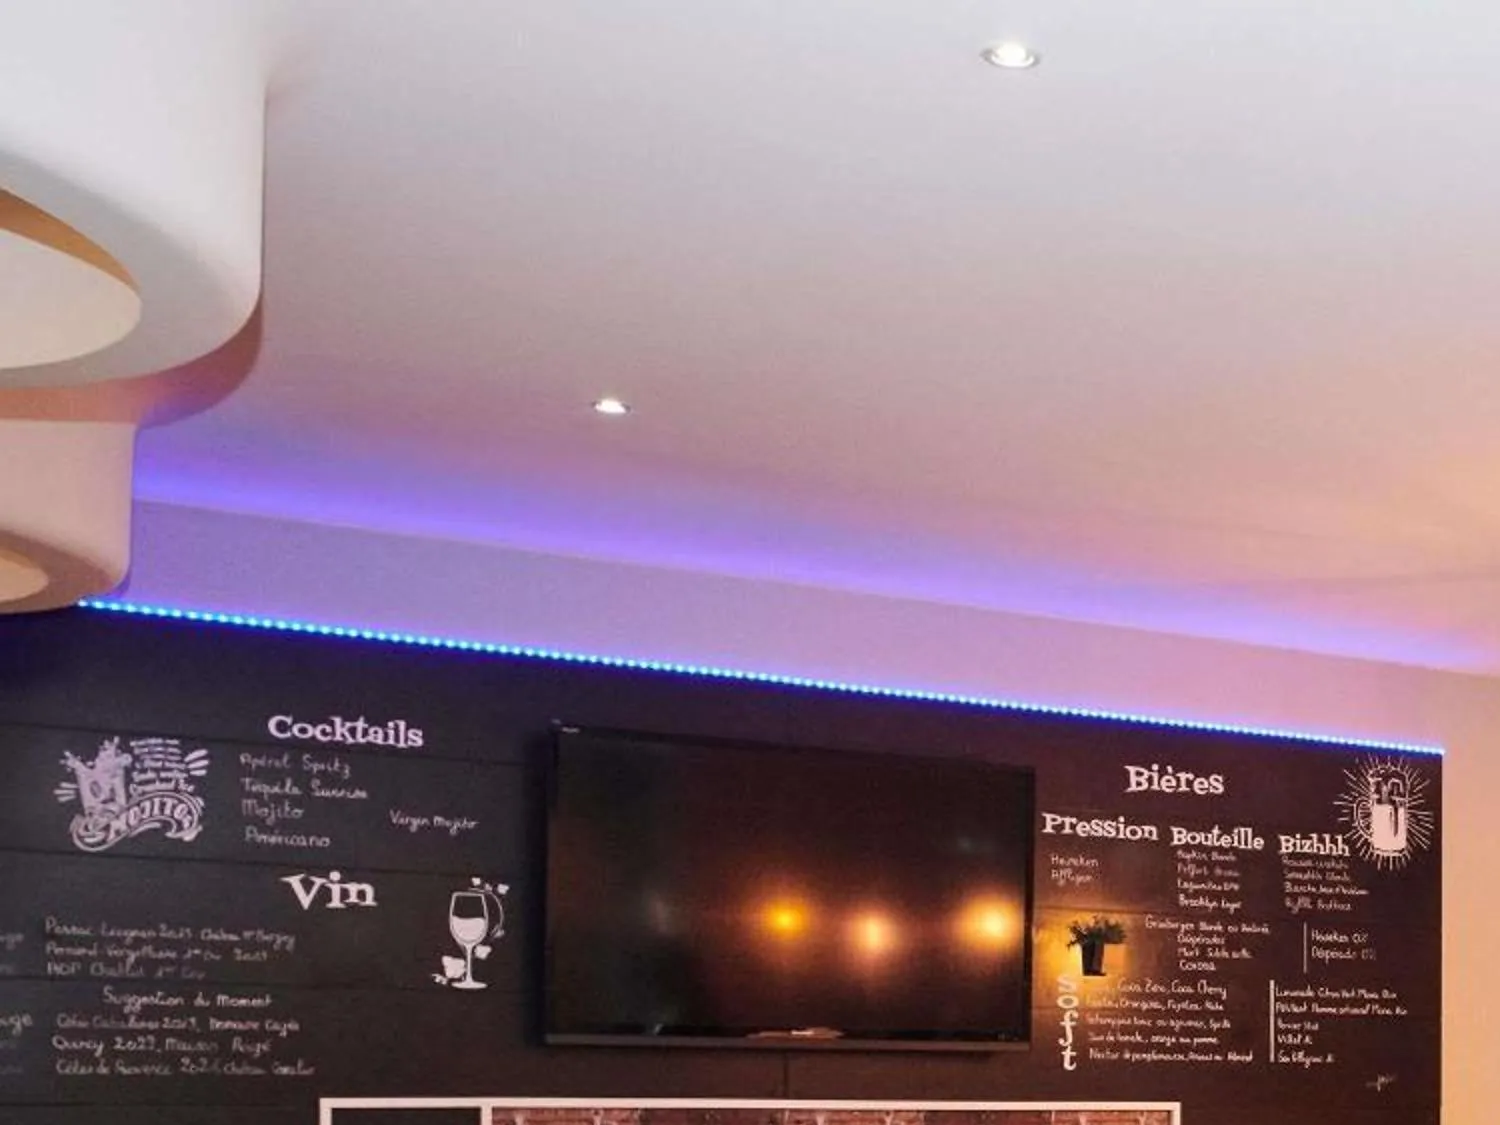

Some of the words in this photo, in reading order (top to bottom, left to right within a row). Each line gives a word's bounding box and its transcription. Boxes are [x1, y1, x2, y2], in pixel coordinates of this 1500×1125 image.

[267, 715, 424, 748] Cocktails
[302, 753, 350, 778] Spritz
[1124, 763, 1225, 795] Bières
[241, 799, 305, 826] Mojito
[433, 815, 480, 837] Mojito
[1041, 813, 1159, 842] Pression
[1170, 825, 1265, 851] Bouteille
[1278, 833, 1350, 857] Bizhhh
[280, 871, 377, 911] Vin
